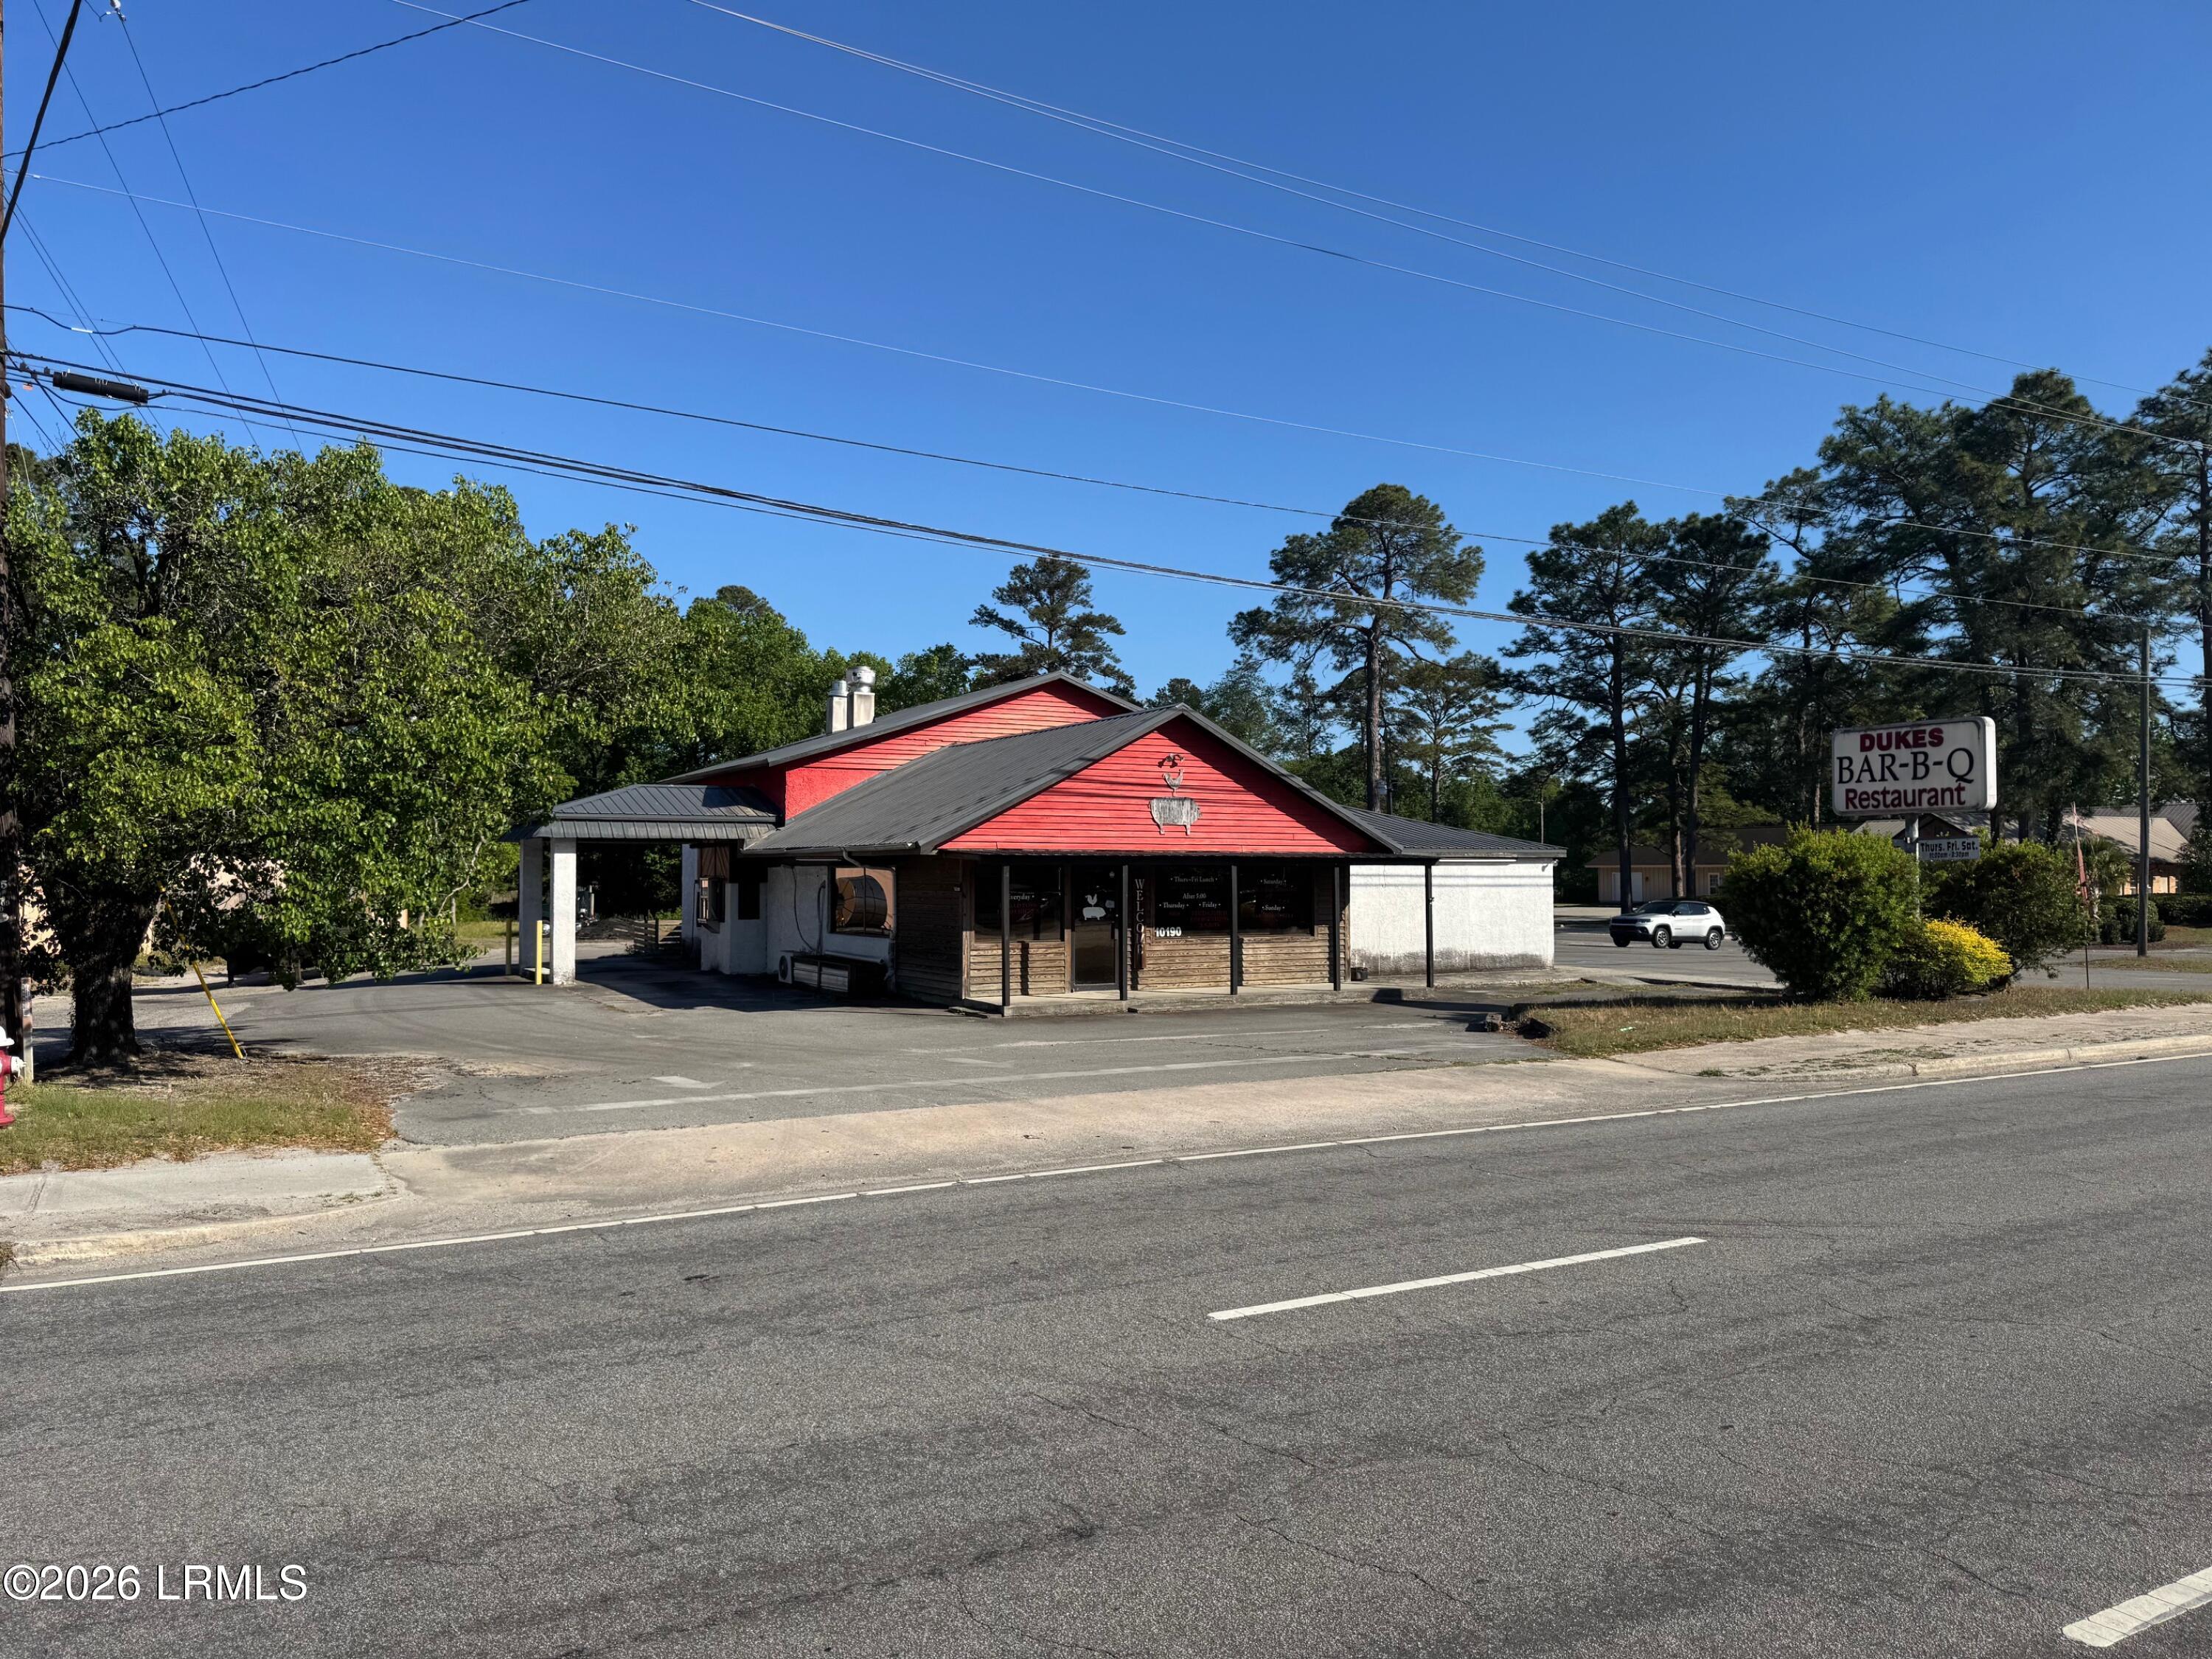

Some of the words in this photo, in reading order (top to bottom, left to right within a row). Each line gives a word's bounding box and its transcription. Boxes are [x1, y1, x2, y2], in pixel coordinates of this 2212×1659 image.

[1860, 728, 1944, 752] DUKES
[1837, 748, 1975, 784] BAR-B-Q
[1845, 783, 1966, 810] Restaurant
[1921, 842, 1945, 852] Thurs.
[1947, 841, 1960, 851] Fri.
[1961, 841, 1978, 850] Sat.
[1009, 893, 1031, 901] veryday
[1135, 878, 1144, 954] WELCOME
[1155, 926, 1182, 937] 10190
